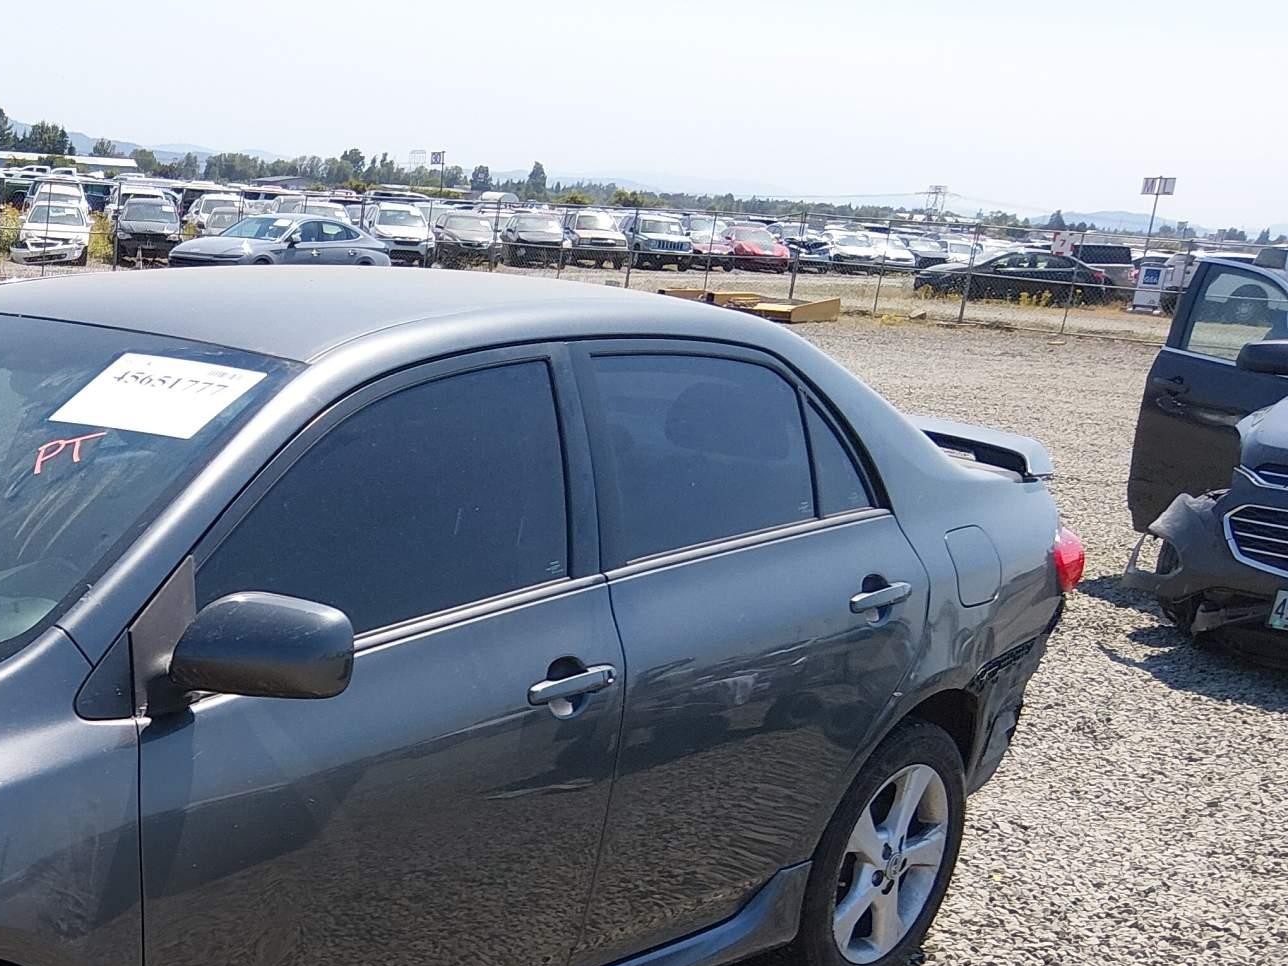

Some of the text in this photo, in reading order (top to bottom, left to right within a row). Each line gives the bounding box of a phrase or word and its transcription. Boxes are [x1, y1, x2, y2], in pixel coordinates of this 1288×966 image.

[1059, 239, 1066, 247] 7
[113, 370, 229, 396] 45651777
[33, 431, 108, 475] PT
[1274, 598, 1288, 620] 4
